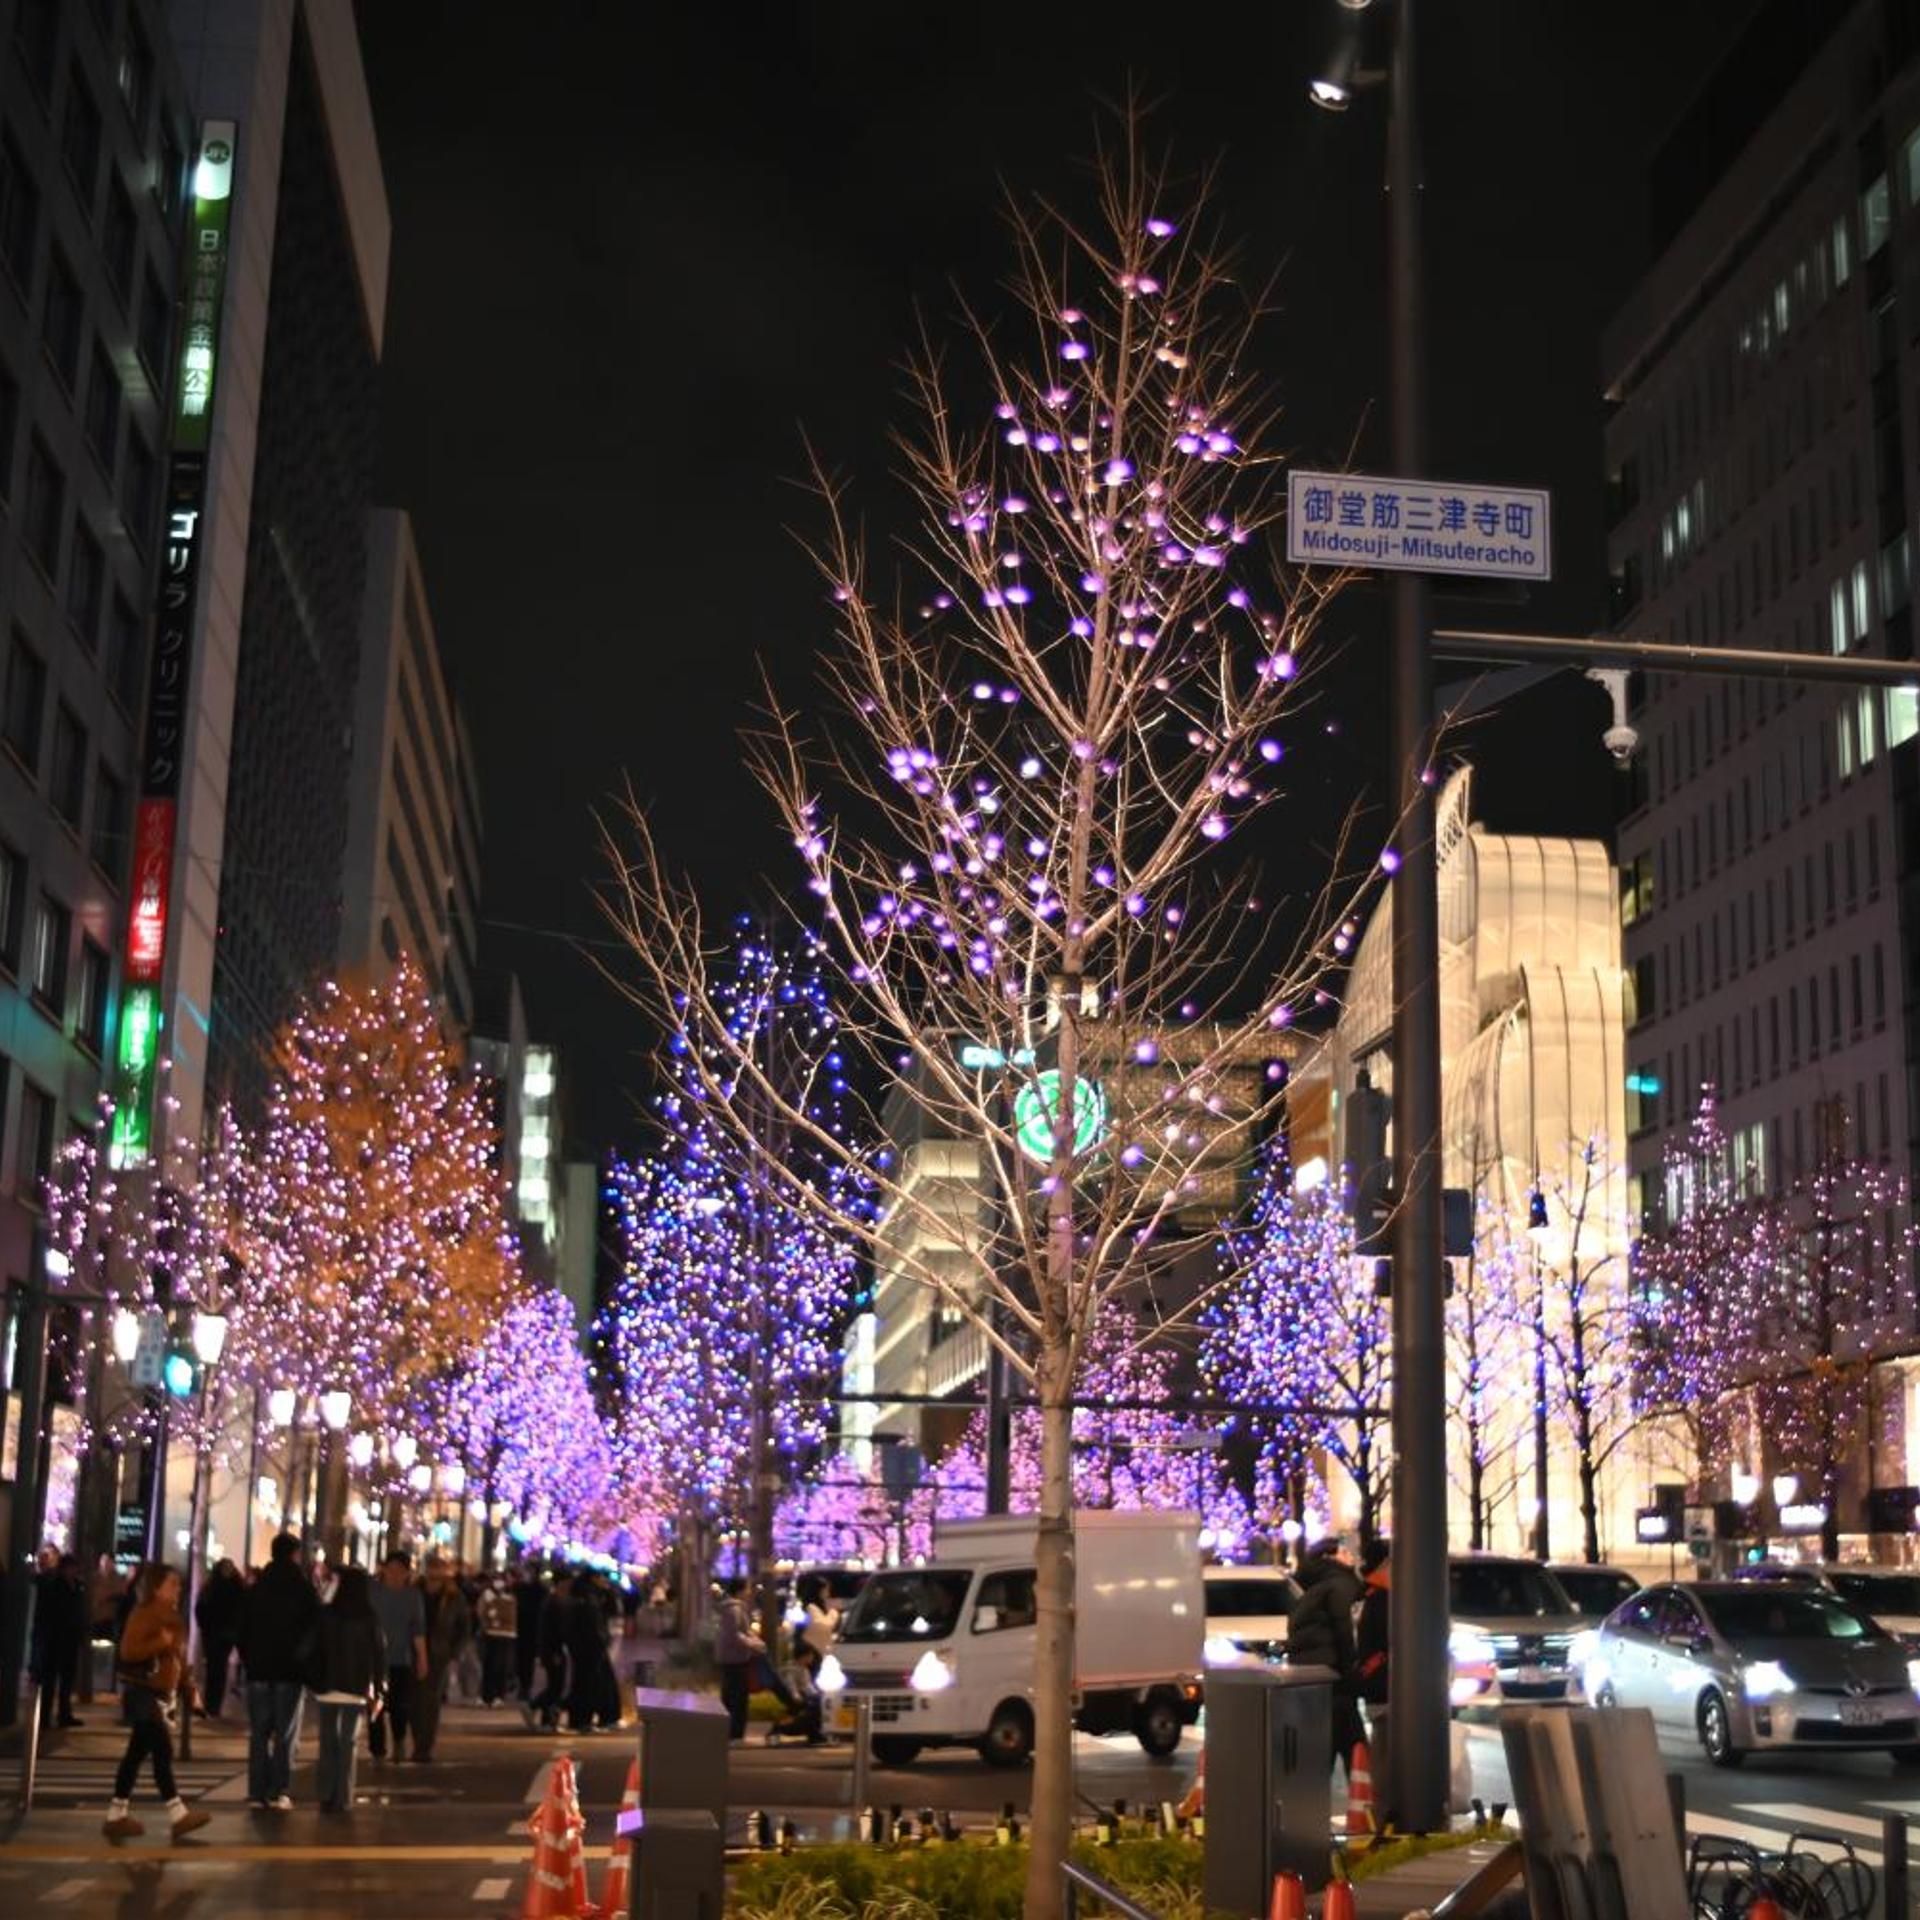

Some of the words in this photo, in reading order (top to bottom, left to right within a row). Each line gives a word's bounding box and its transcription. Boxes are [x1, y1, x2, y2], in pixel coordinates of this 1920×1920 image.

[1303, 486, 1533, 540] 御堂筋三津寺町
[1303, 530, 1535, 566] Midosuji-Mitsuteracho
